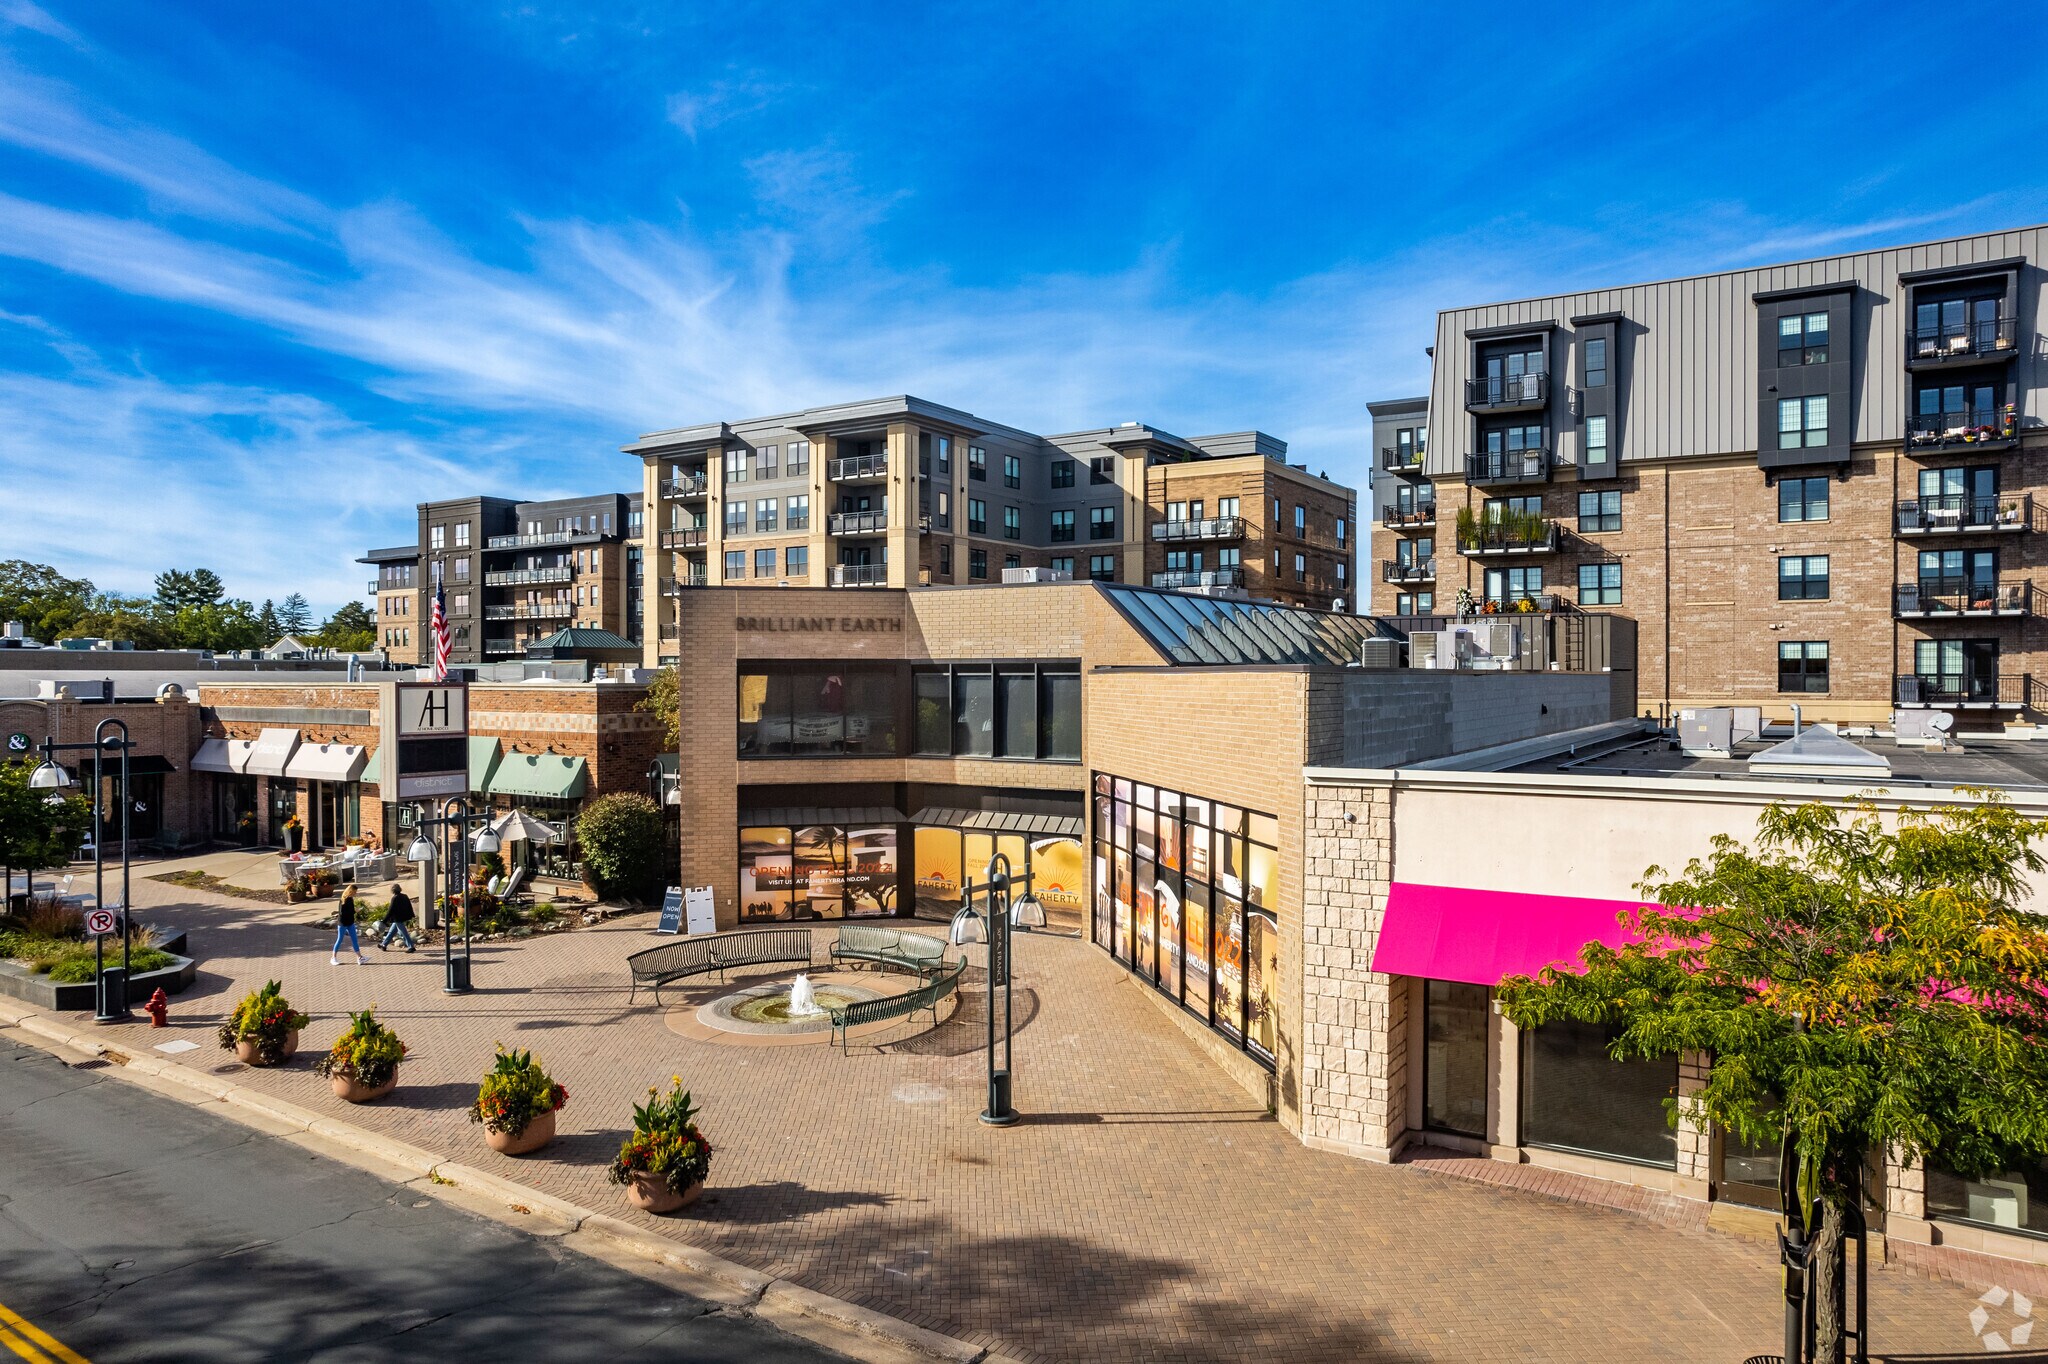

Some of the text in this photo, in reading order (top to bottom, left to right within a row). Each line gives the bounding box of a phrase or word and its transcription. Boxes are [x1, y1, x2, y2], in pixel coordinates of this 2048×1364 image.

[736, 617, 901, 632] BRILLIANT EARTH
[419, 690, 448, 727] AH
[415, 777, 452, 787] district
[749, 862, 891, 877] OPENING FALL 2022
[805, 876, 870, 884] FAHERTYBRAND.COM
[917, 880, 958, 892] FAHERTY
[1034, 891, 1079, 904] FAHERTY
